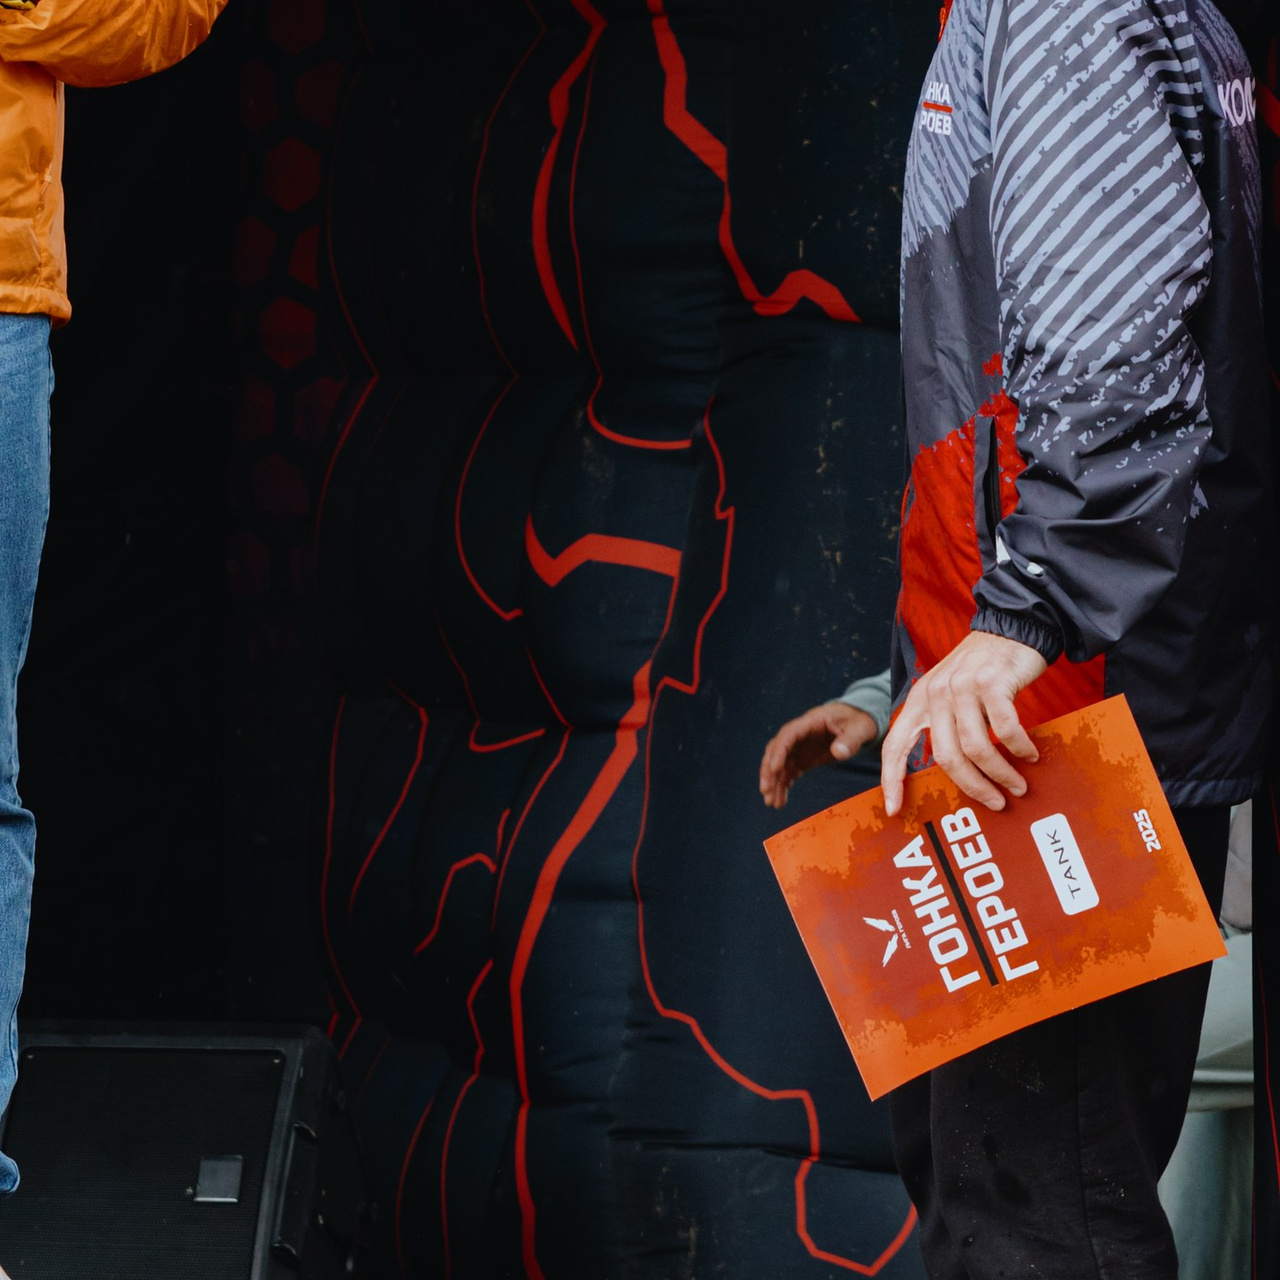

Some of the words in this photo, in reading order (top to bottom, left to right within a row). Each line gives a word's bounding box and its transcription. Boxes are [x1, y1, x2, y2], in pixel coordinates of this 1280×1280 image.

[925, 81, 950, 104] НКА
[919, 111, 952, 135] РОЕВ
[1133, 808, 1162, 853] 2025
[1046, 829, 1081, 899] TANK
[893, 834, 981, 993] ГОНКА
[941, 807, 1040, 981] ГЕРОЕВ
